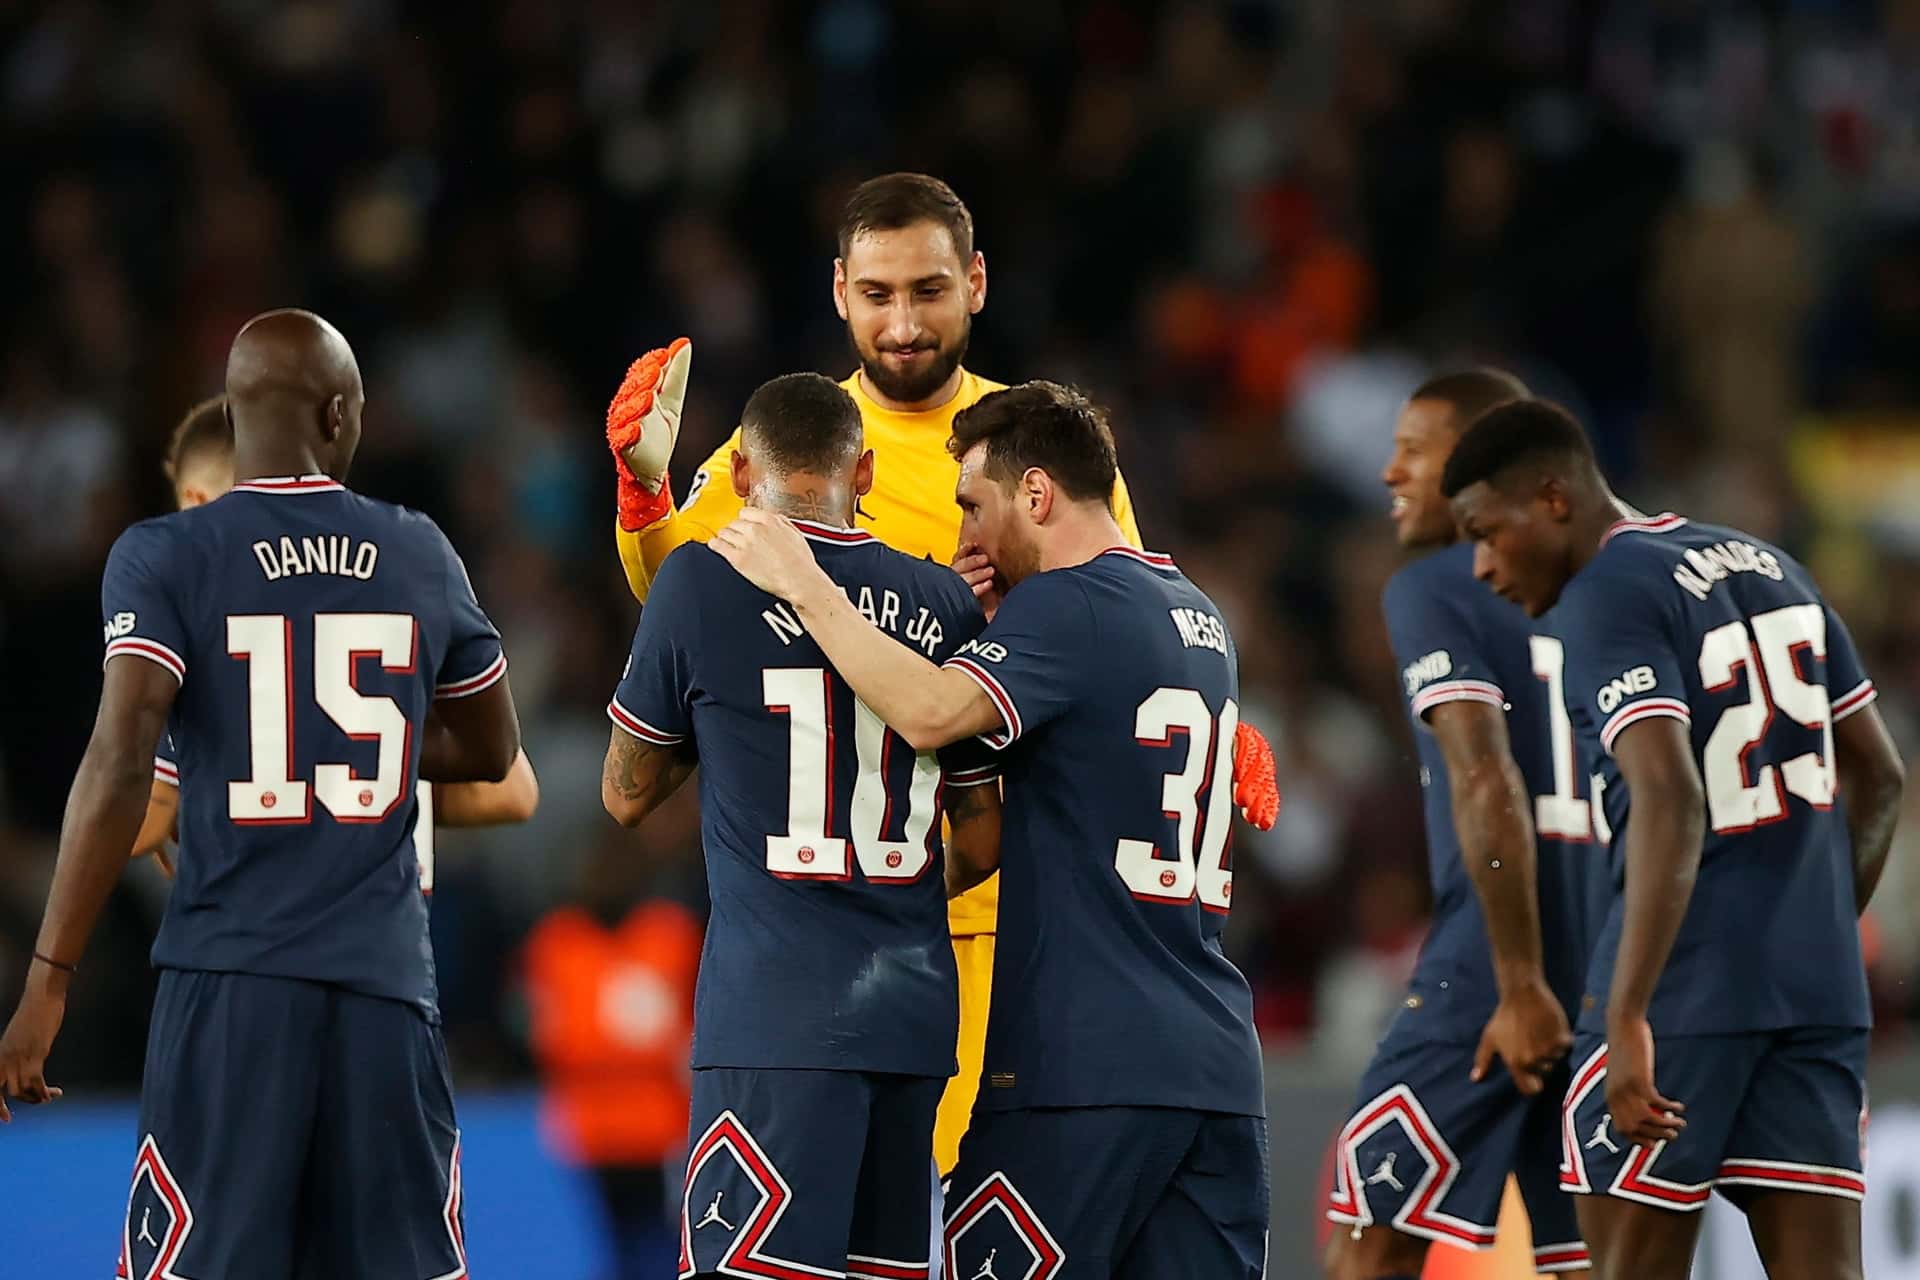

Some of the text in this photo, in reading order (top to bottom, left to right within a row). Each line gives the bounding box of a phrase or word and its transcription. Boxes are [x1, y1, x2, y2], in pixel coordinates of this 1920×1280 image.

[253, 535, 379, 581] DANILO
[103, 611, 136, 644] NB
[761, 585, 944, 657] NAR JR
[226, 613, 418, 824] 15
[1597, 665, 1657, 713] QNB
[1698, 603, 1839, 836] 25
[762, 668, 945, 884] 10
